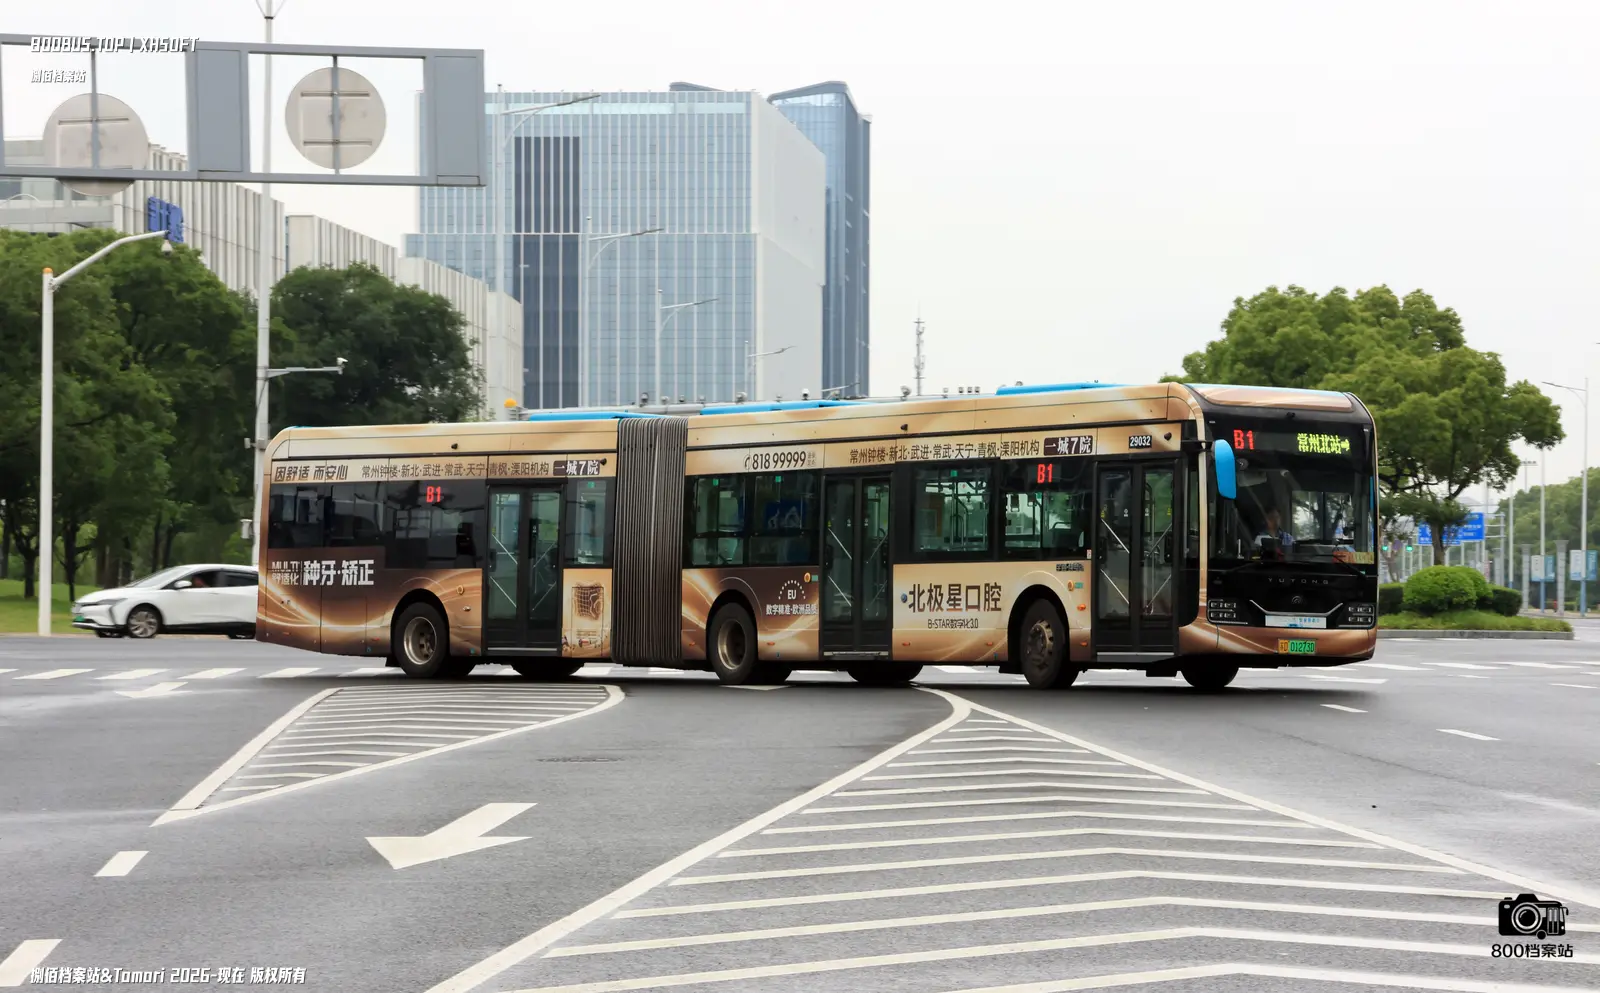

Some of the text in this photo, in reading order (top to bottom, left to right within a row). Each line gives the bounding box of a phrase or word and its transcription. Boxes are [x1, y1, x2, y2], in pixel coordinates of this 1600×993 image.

[1129, 435, 1151, 447] 29032
[1233, 429, 1254, 450] B1
[1297, 433, 1341, 454] 常州北站
[1037, 463, 1053, 483] B1
[426, 486, 441, 503] B1
[787, 589, 797, 600] EU
[908, 582, 1001, 613] 北极星口腔
